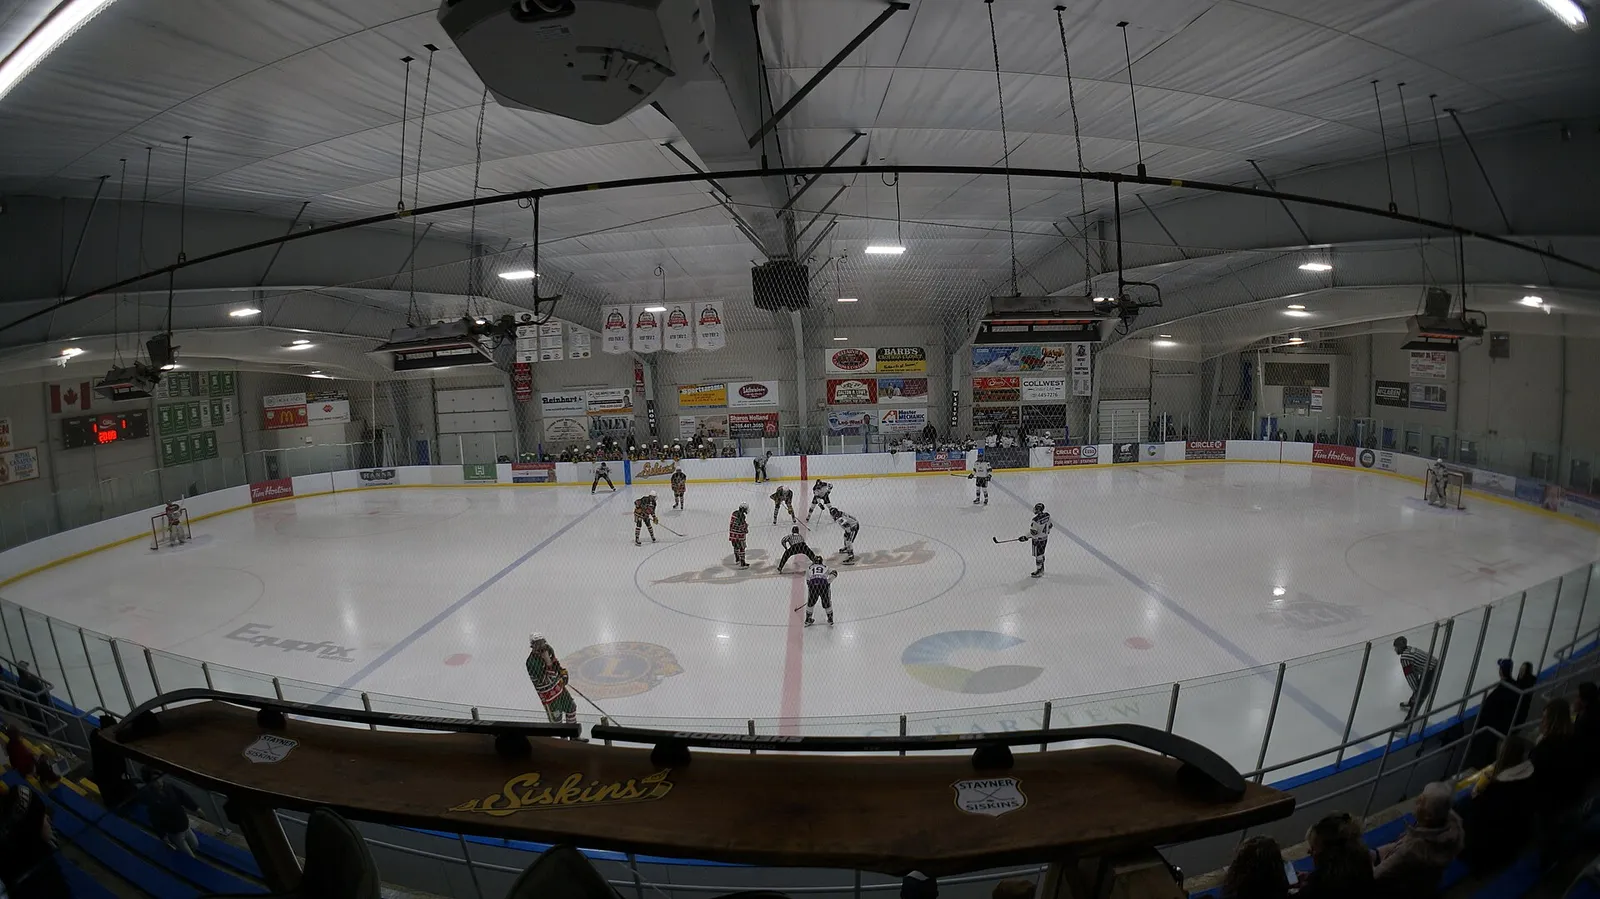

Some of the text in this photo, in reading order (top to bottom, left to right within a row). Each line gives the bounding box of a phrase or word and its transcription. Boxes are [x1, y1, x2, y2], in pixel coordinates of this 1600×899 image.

[541, 395, 578, 404] Reinhart
[951, 391, 959, 426] VISITOR
[648, 408, 656, 428] HOME
[1314, 449, 1355, 463] Tim Hortons
[252, 485, 292, 499] Tim Hortons
[812, 566, 824, 575] 19
[261, 735, 297, 748] STAYNER
[246, 749, 279, 762] SISKINS
[959, 779, 1014, 790] STAYNER
[482, 771, 648, 817] Siskins
[966, 800, 1019, 811] SISKINS
